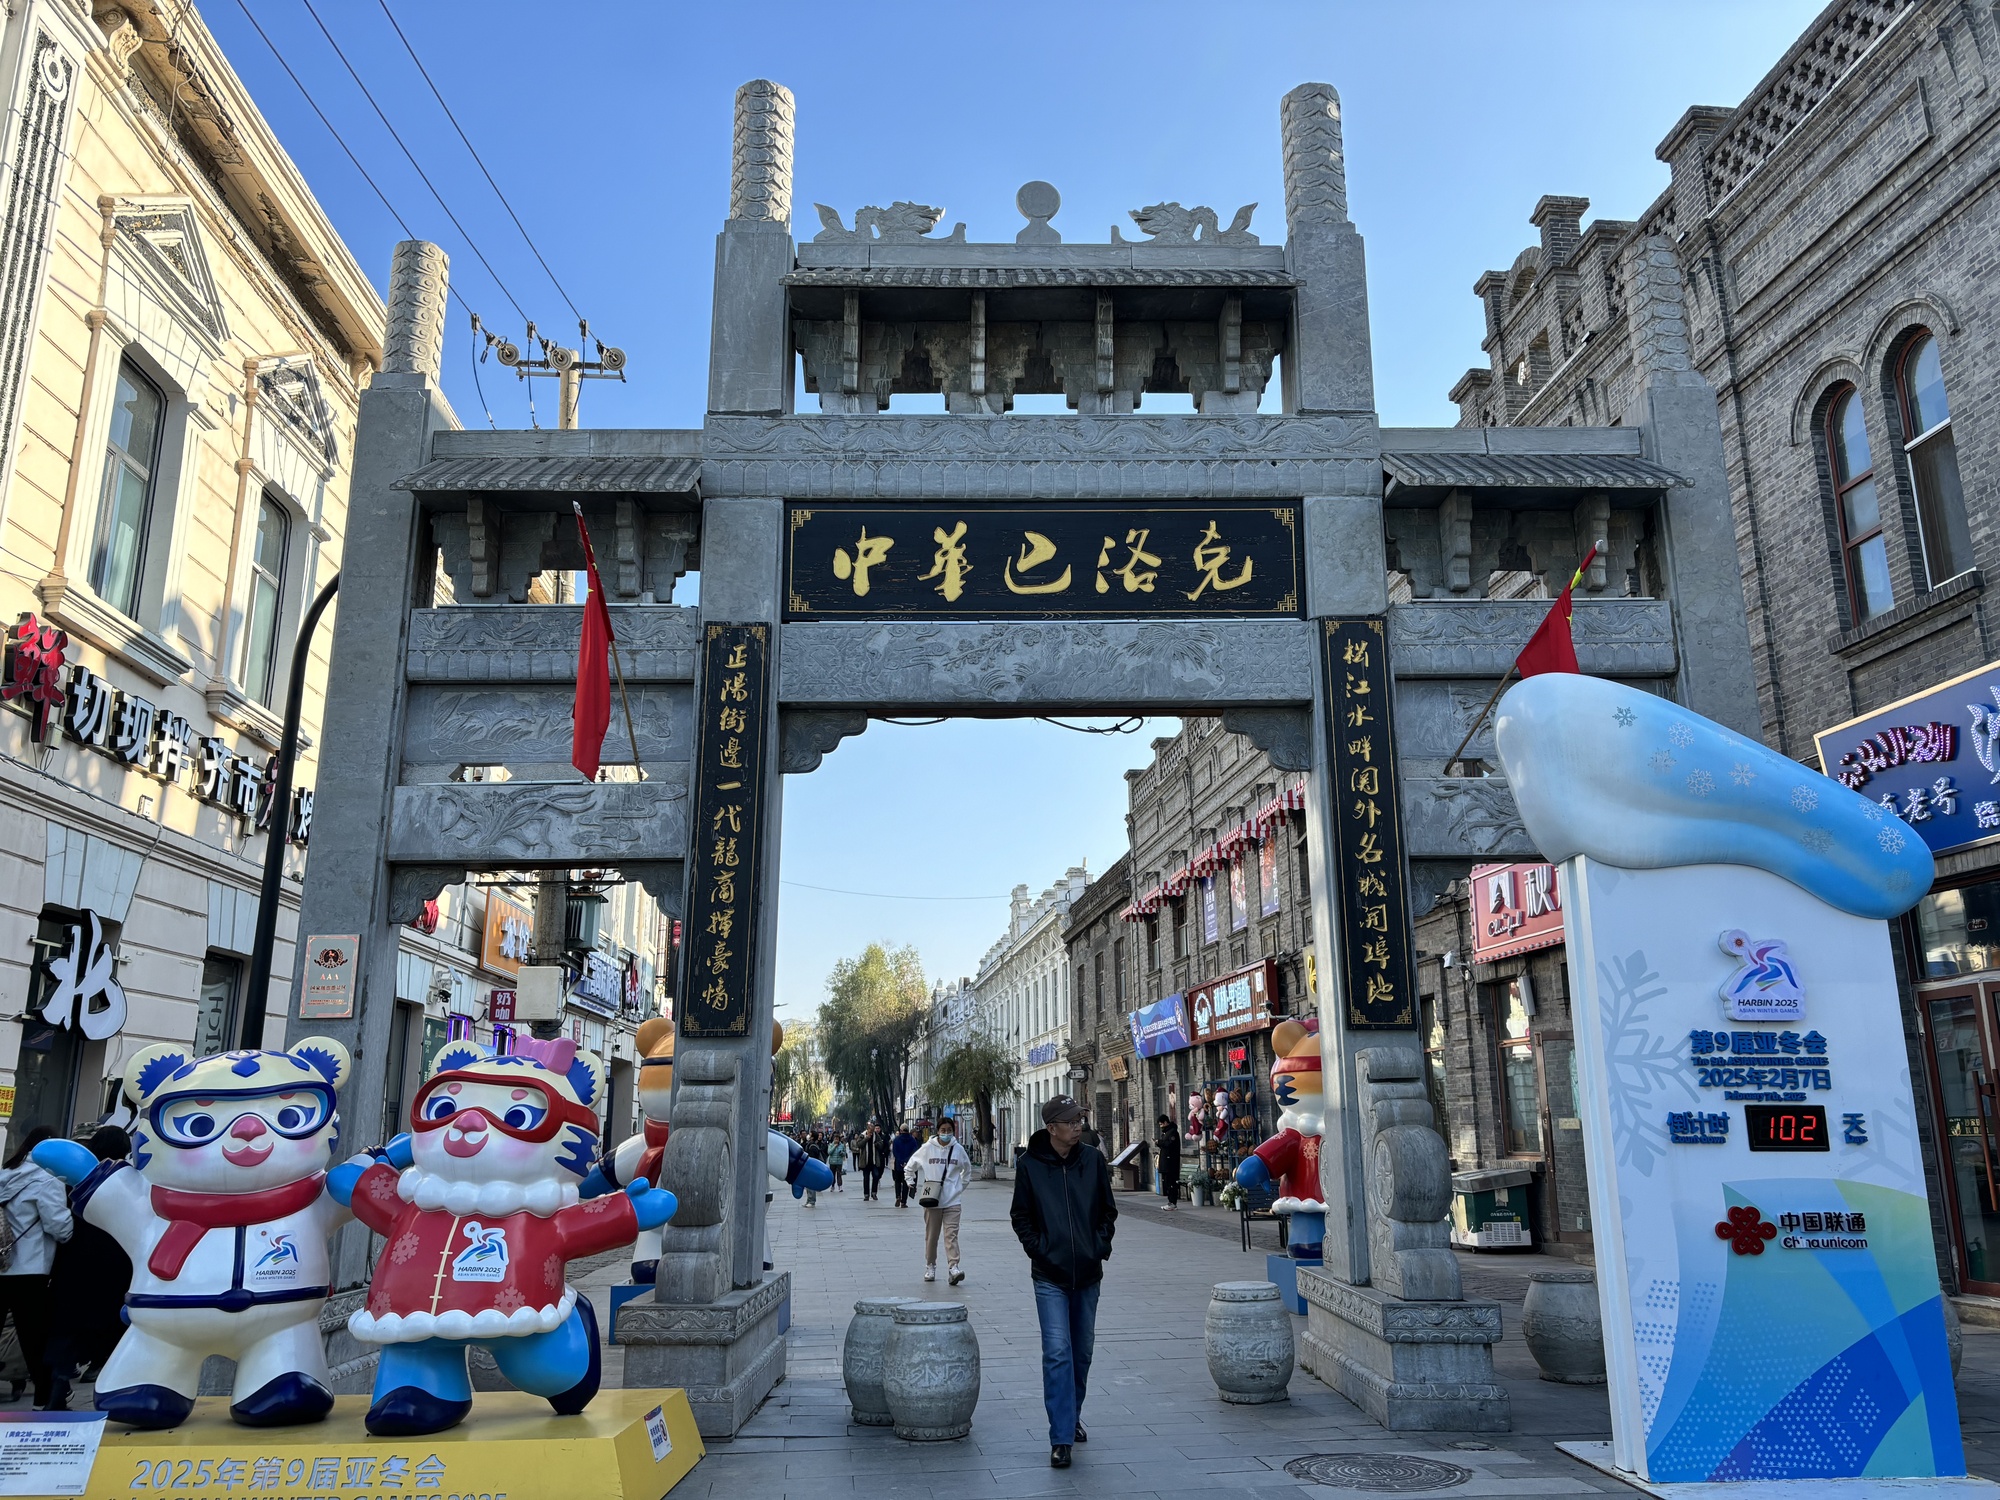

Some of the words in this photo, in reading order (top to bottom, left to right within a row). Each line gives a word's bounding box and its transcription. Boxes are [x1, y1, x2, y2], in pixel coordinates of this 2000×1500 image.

[1737, 998, 1773, 1007] HARBIN
[1774, 999, 1798, 1008] 2025
[1689, 1030, 1828, 1055] 第9届亚冬会
[1697, 1067, 1832, 1091] 2025年2月7日
[1666, 1110, 1731, 1135] 倒计时
[1769, 1115, 1817, 1141] 102
[1842, 1112, 1867, 1135] 天
[1779, 1211, 1867, 1233] 中国联通
[129, 1453, 448, 1491] 2025年第9届亚冬会
